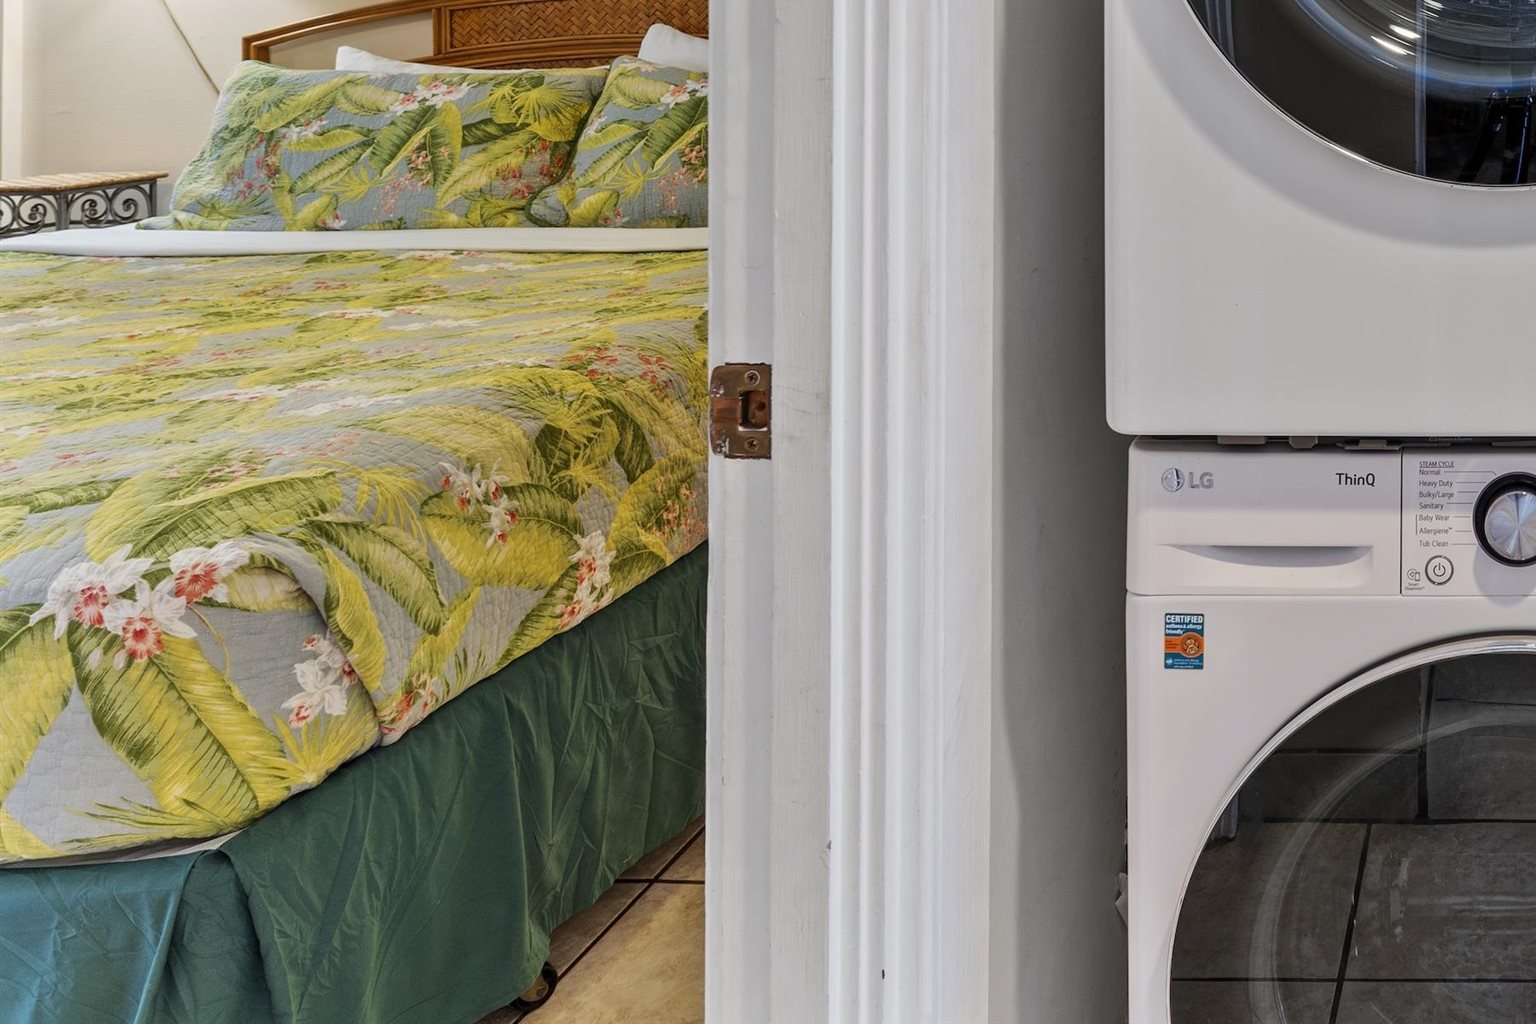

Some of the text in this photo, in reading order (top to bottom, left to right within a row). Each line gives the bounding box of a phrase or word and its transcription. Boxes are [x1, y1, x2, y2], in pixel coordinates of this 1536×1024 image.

[1188, 472, 1214, 489] LG
[1336, 472, 1376, 487] ThinQ
[1419, 480, 1454, 488] Heavy Duty
[1418, 491, 1454, 499] Bulky/Large
[1419, 502, 1444, 510] Sanitary
[1419, 514, 1434, 522] Baby
[1166, 615, 1203, 624] CERTIFIED
